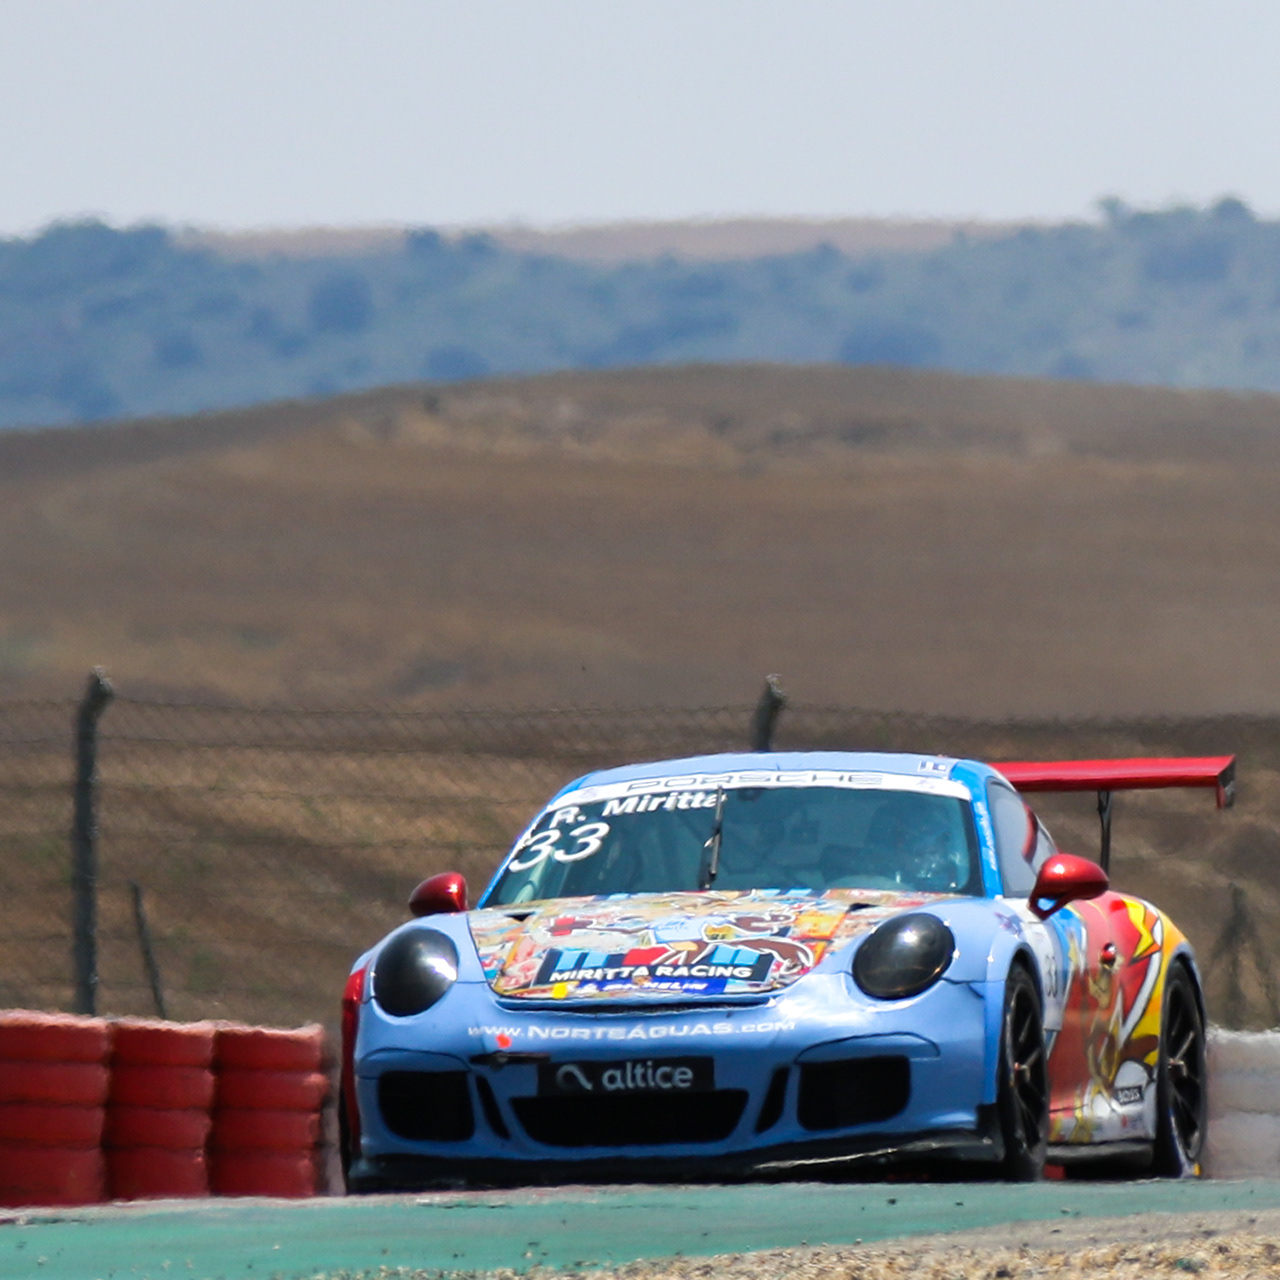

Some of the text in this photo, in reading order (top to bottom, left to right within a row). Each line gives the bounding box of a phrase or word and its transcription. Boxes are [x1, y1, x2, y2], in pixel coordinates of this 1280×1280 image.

[626, 774, 883, 792] PORSCHE
[549, 791, 728, 829] R. Miritta
[508, 821, 611, 873] 33
[550, 964, 753, 982] MIRITTA RACING
[601, 1060, 694, 1090] altice
